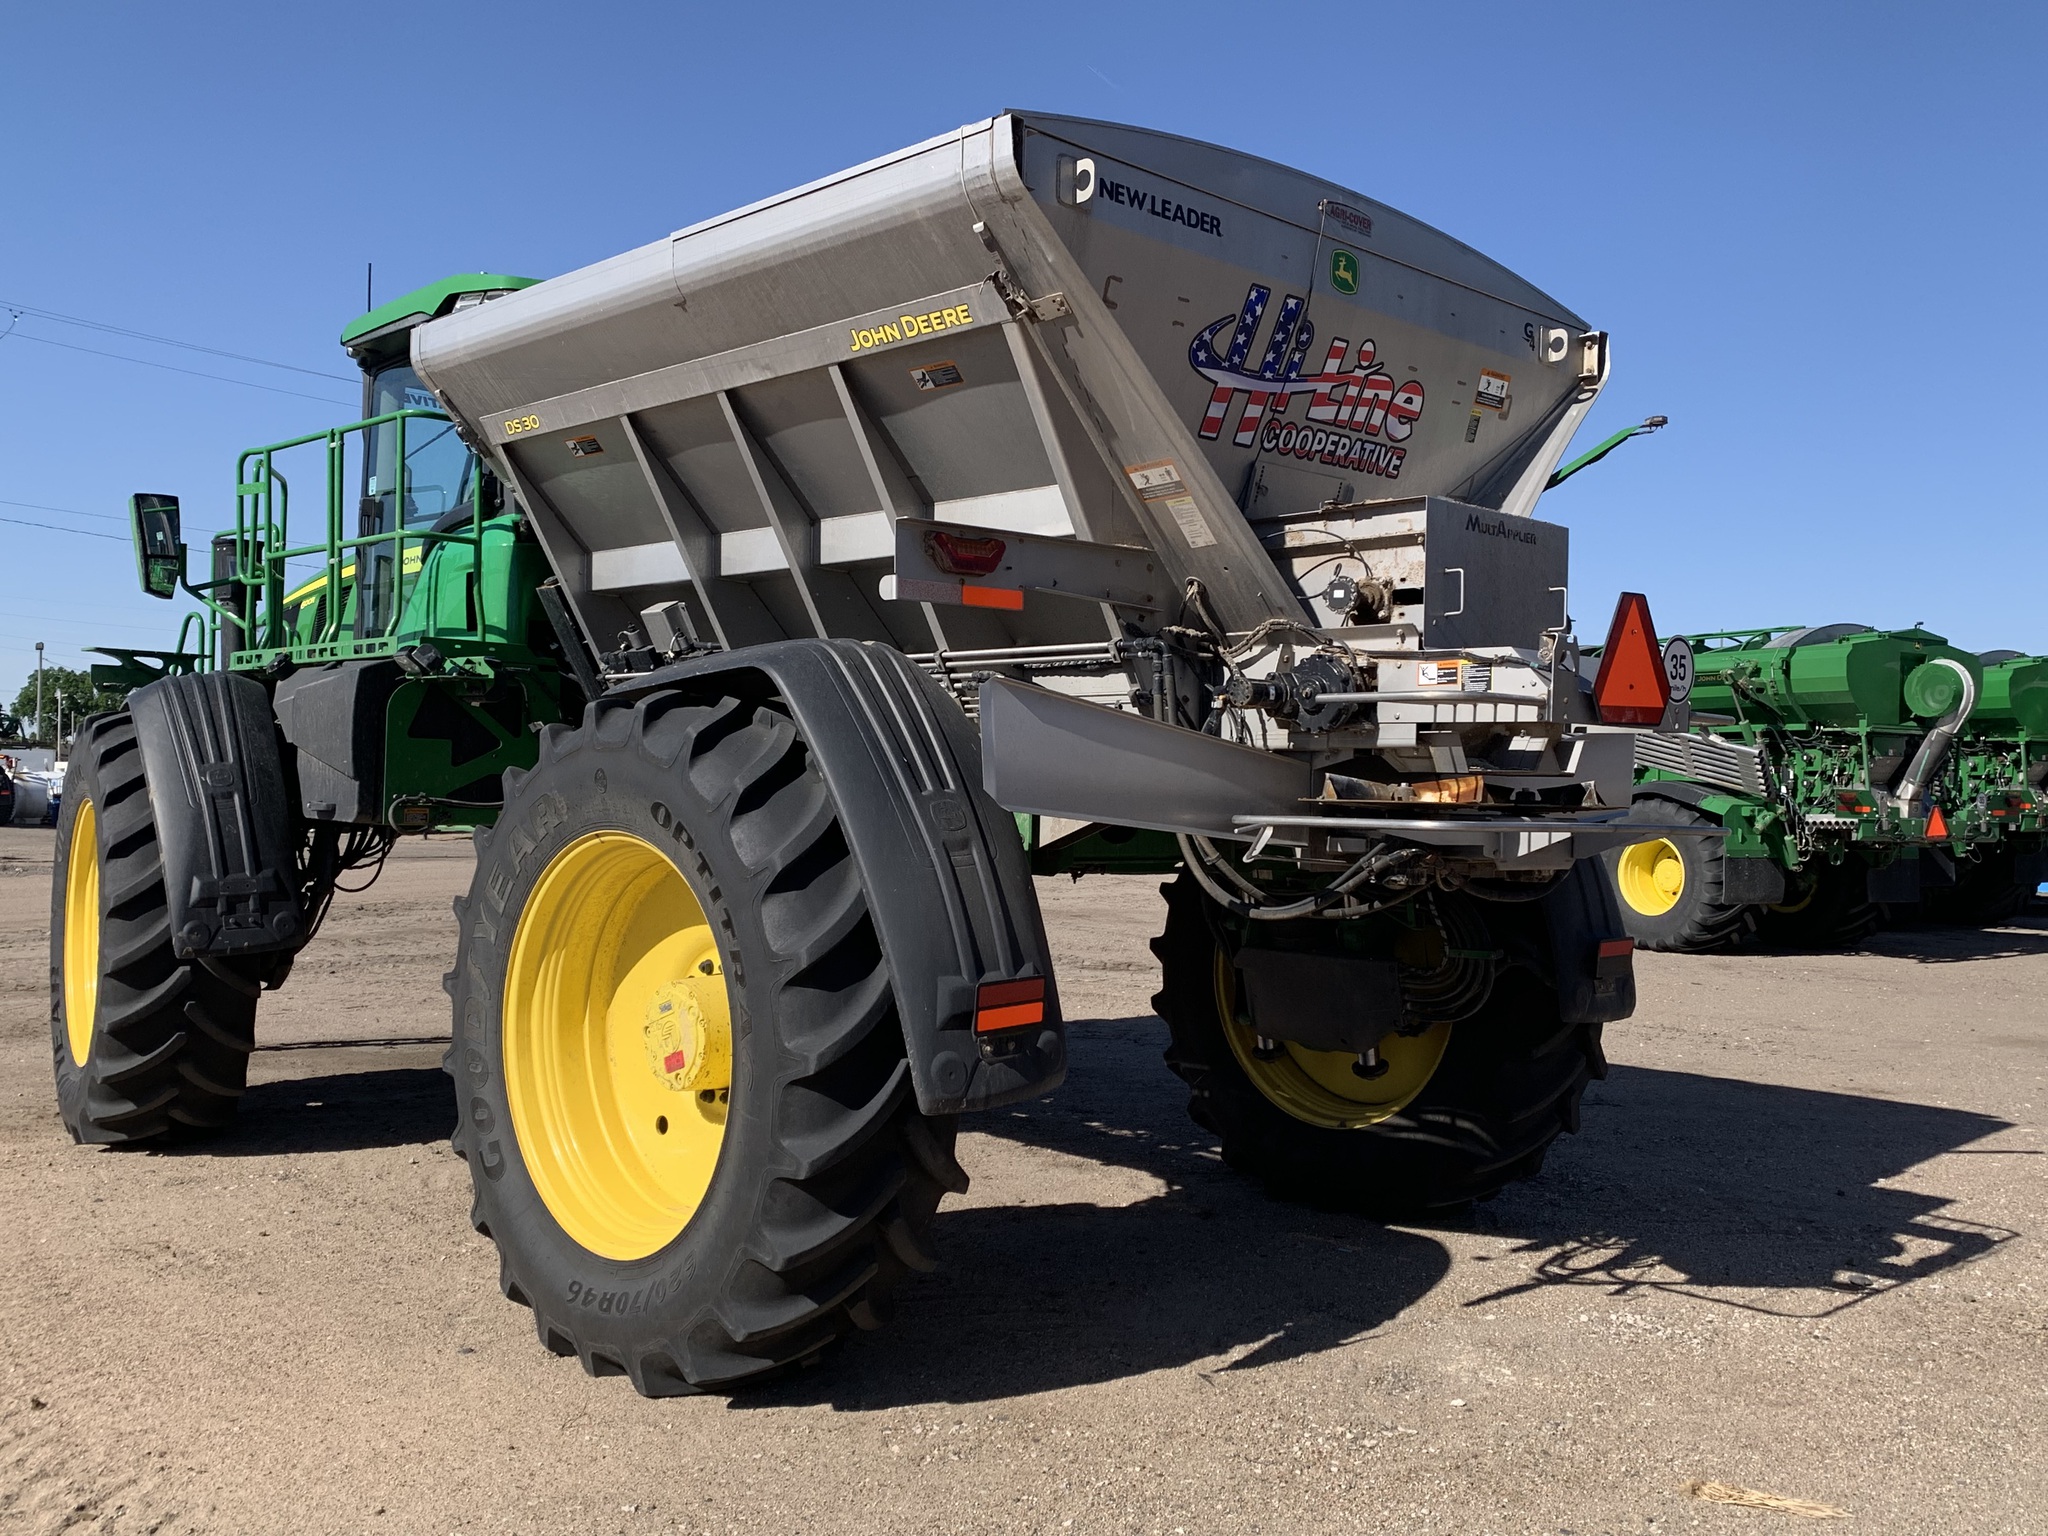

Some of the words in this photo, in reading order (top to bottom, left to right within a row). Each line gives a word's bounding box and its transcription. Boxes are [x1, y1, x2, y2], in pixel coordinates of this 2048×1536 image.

[1099, 177, 1148, 211] NEW
[1150, 195, 1222, 237] LEADER
[850, 322, 902, 352] JOHN
[899, 303, 974, 338] DEERE
[1261, 417, 1407, 480] COOPERATIVE
[403, 555, 421, 566] OHN
[1670, 653, 1687, 681] 35
